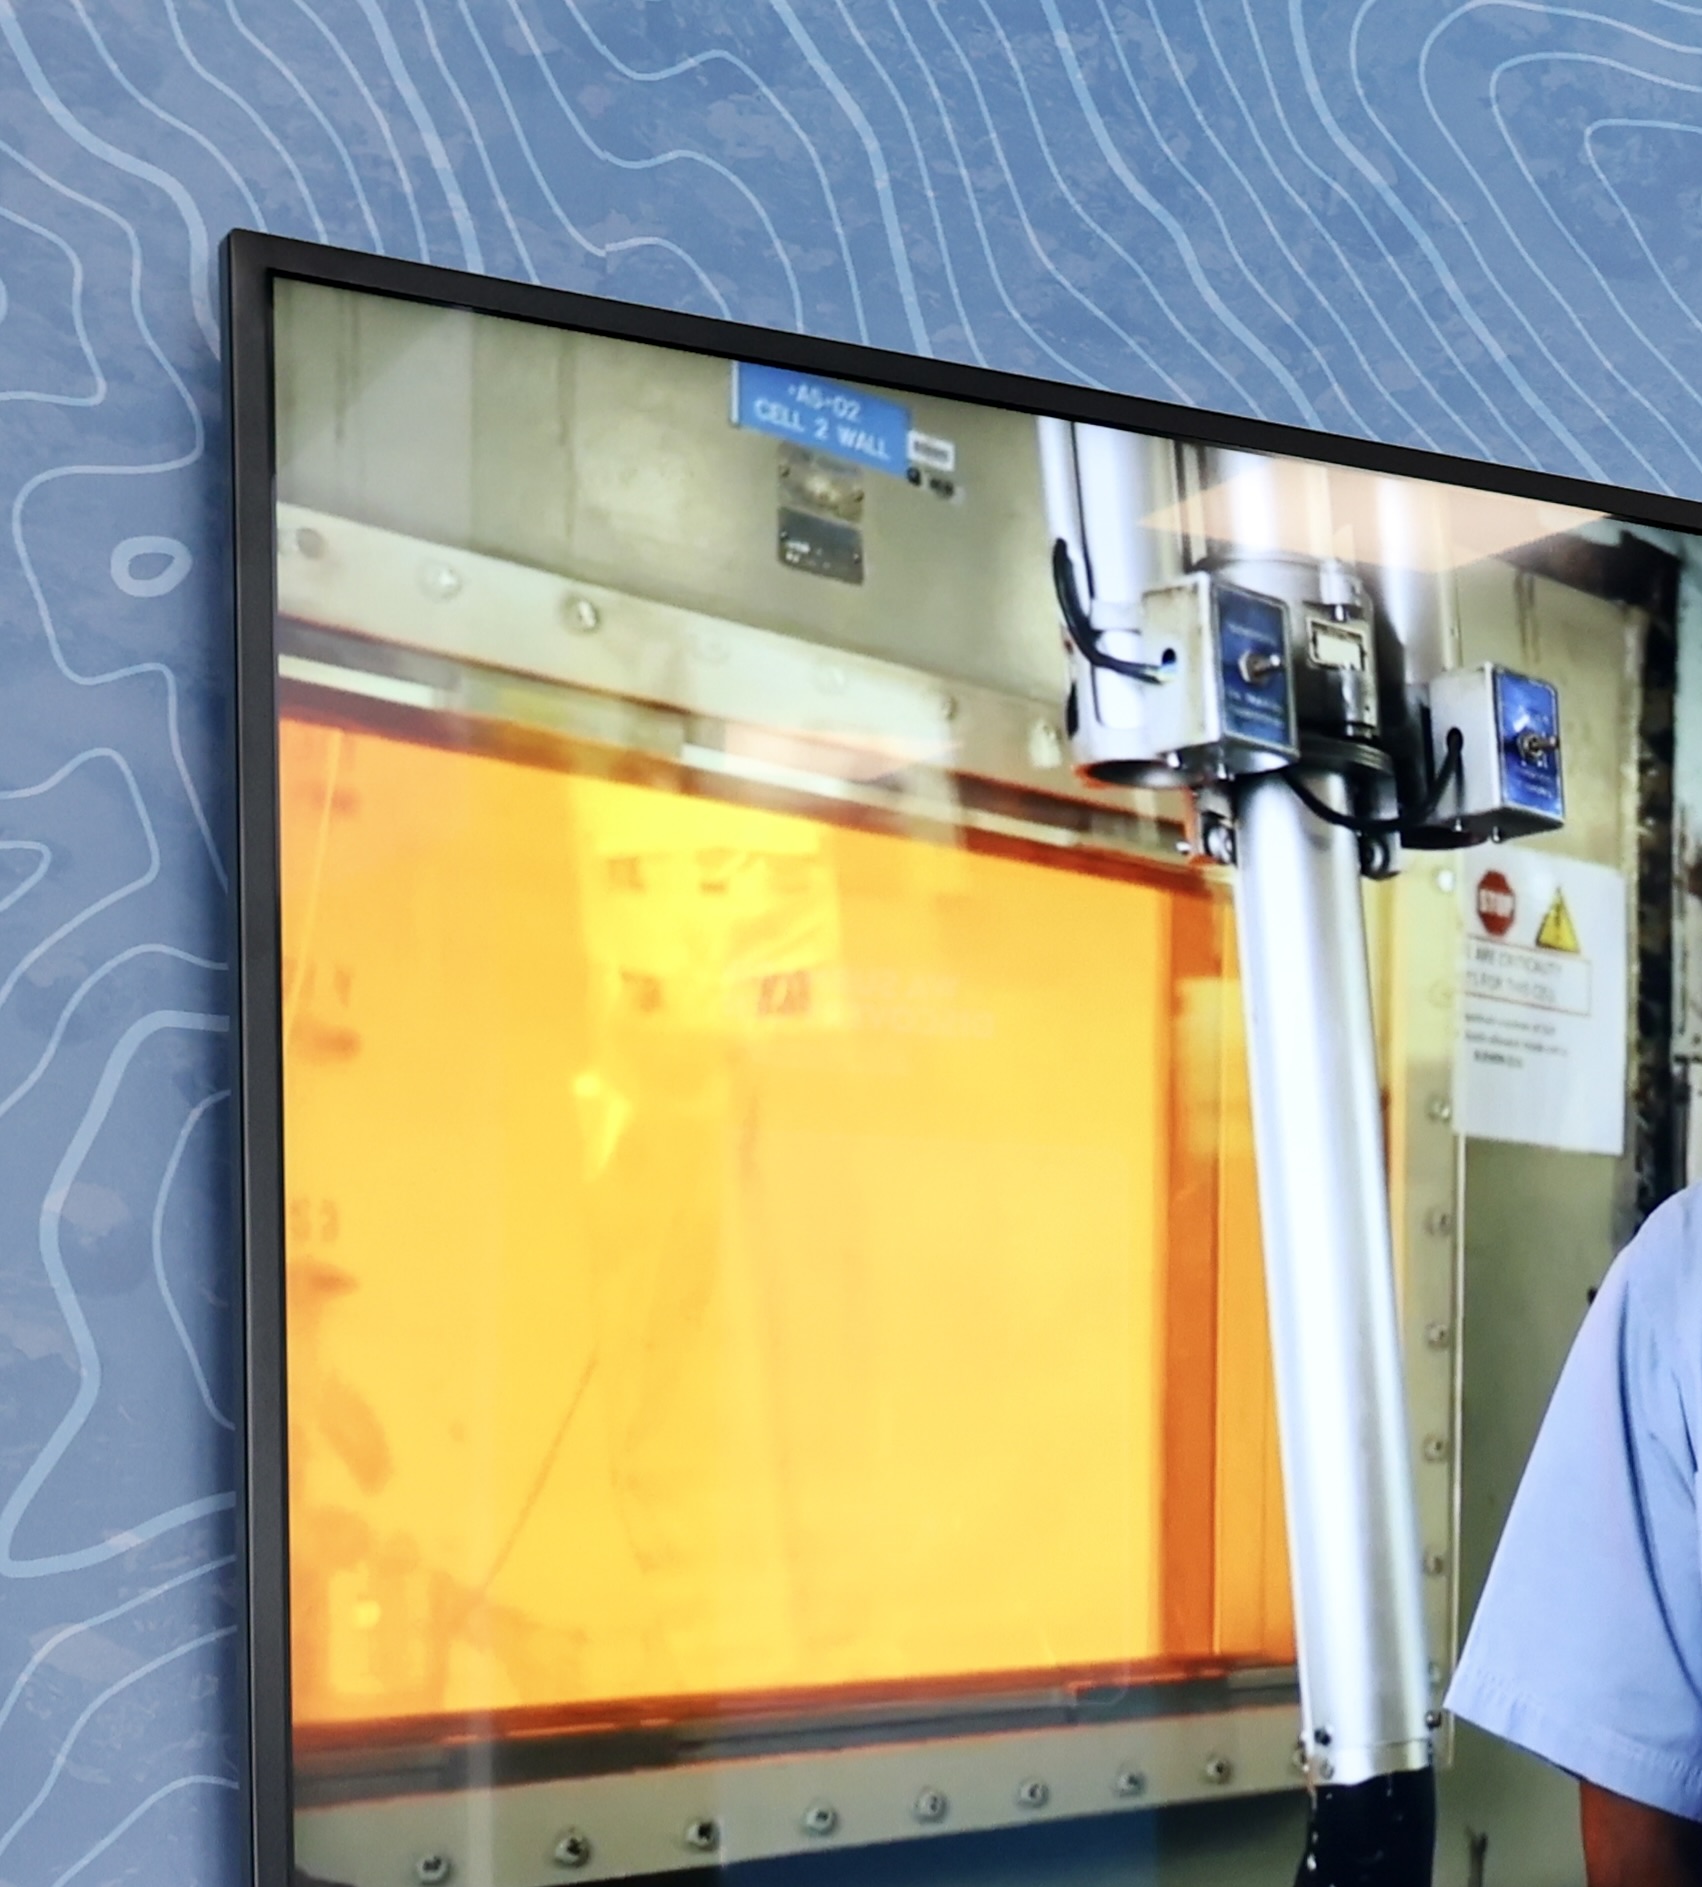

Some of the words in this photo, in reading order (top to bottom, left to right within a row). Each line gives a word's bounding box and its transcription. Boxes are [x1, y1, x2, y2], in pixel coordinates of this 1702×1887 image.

[754, 397, 805, 433] CELL
[814, 417, 828, 441] 2
[837, 424, 891, 460] WALL
